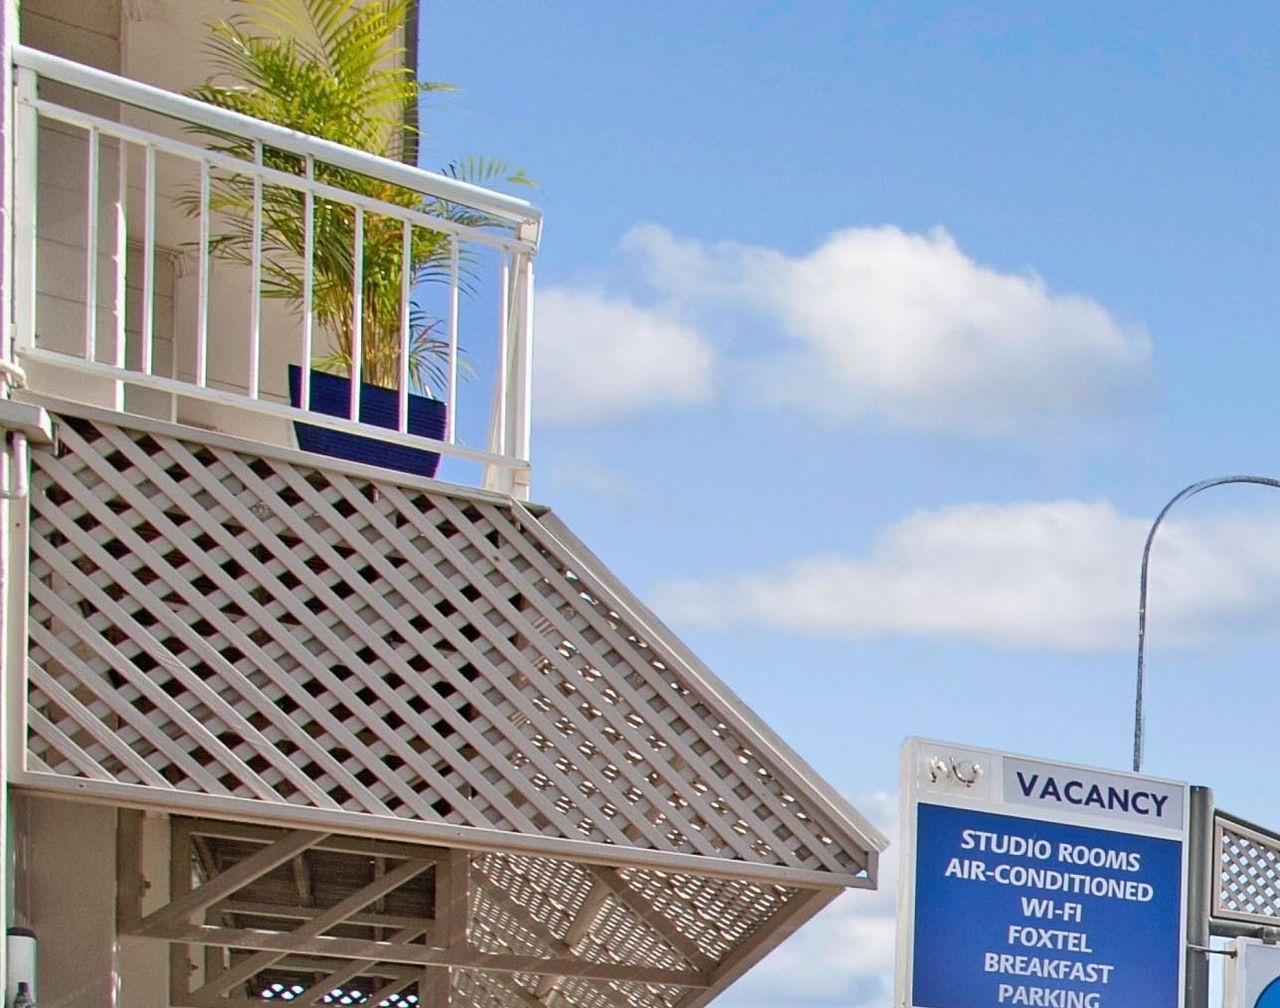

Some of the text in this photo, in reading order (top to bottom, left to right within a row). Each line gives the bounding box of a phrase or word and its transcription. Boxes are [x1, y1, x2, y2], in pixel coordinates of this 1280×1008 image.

[1016, 771, 1169, 818] VACANCY
[960, 829, 1141, 873] STUDIO ROOMS
[944, 857, 1154, 902] AIR-CONDITIONED
[1021, 896, 1082, 923] WI-FI
[1007, 924, 1093, 953] FOXTEL
[983, 952, 1115, 985] BREAKFAST
